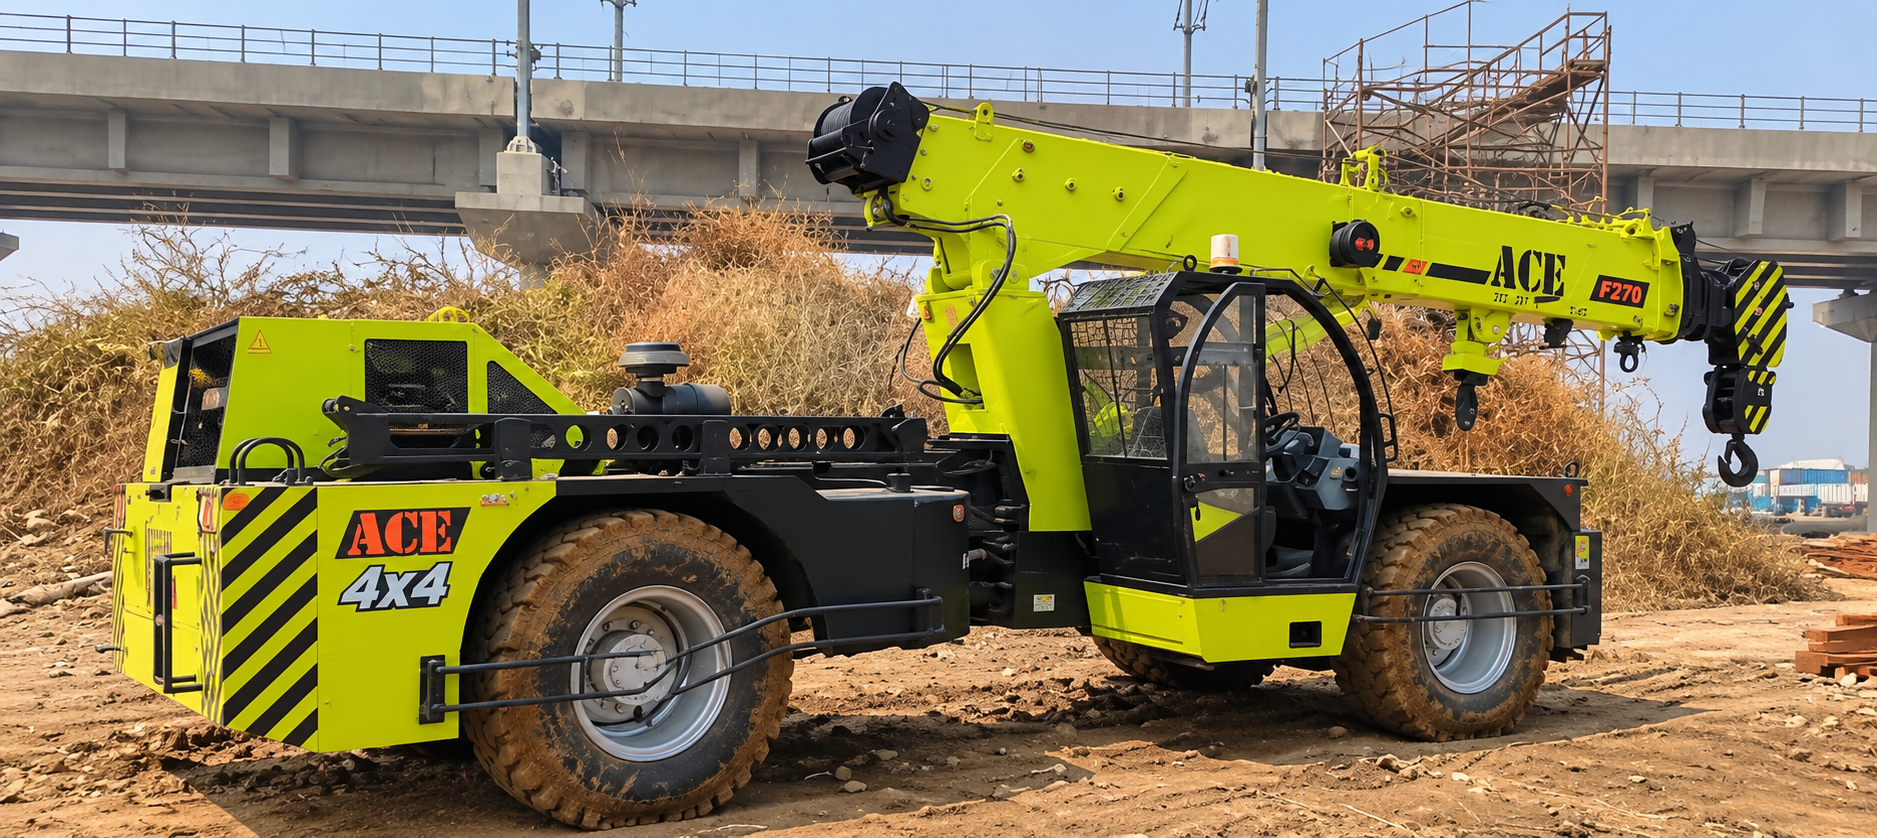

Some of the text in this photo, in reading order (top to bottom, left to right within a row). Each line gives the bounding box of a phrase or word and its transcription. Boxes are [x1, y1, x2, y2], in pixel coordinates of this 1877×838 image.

[1490, 245, 1566, 297] ACE
[1598, 280, 1642, 304] F270
[347, 510, 451, 556] ACE
